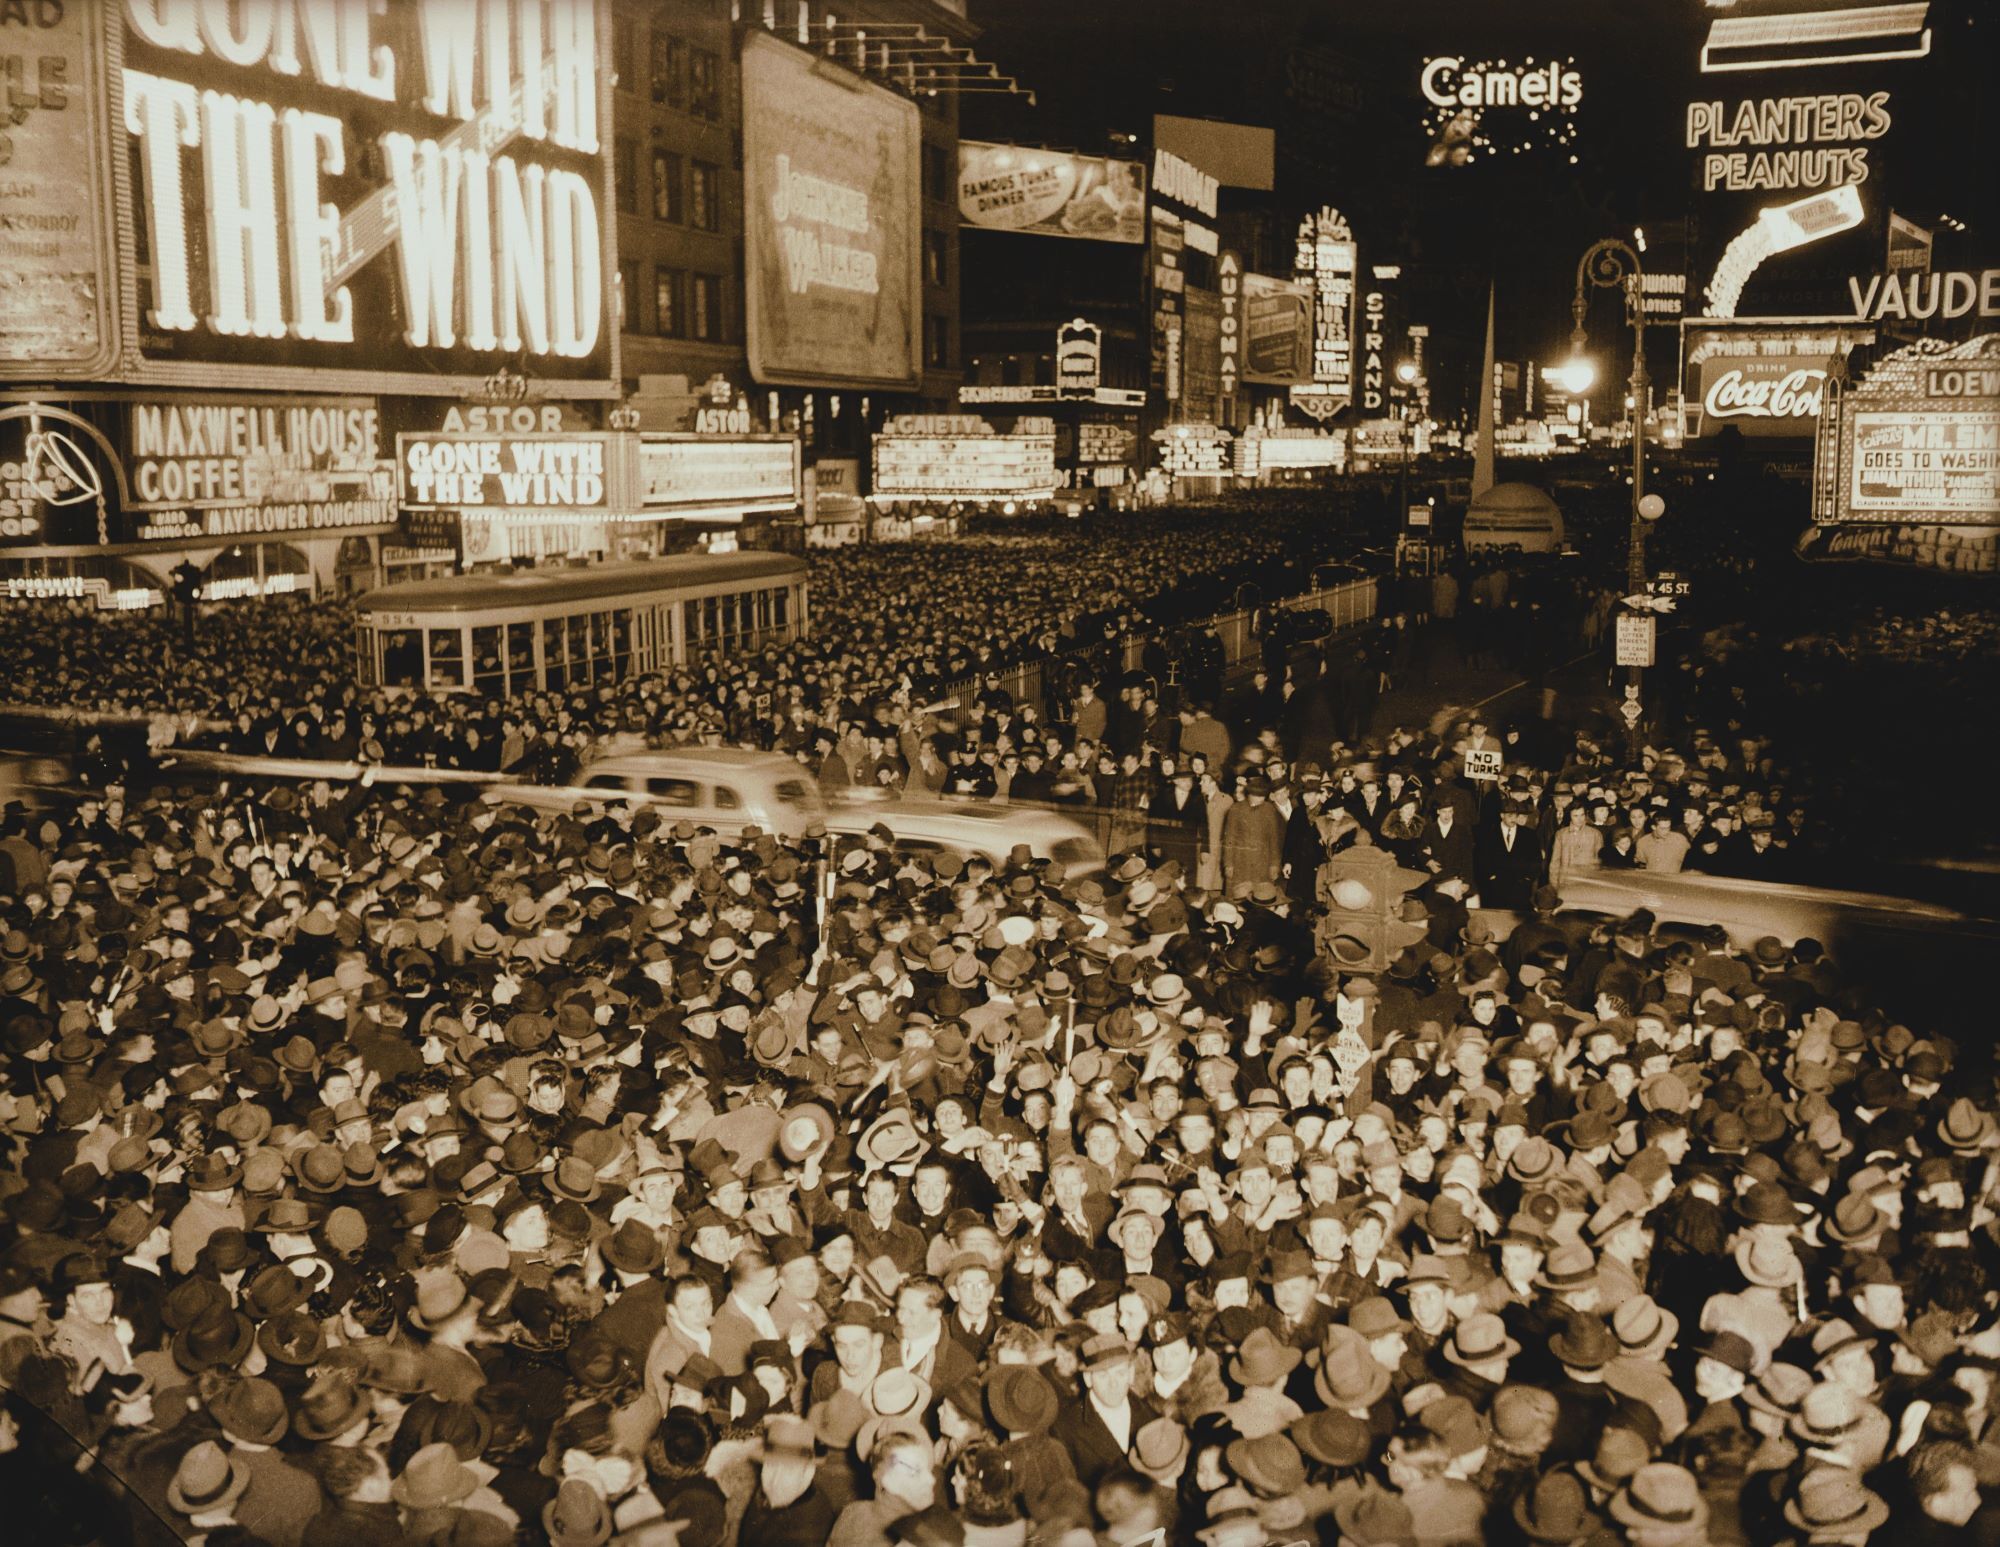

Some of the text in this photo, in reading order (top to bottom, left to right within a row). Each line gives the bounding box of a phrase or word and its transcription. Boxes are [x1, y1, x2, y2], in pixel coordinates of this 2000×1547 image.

[0, 54, 68, 111] LE
[1421, 57, 1582, 106] Camels
[1686, 92, 1891, 148] PLANTERS
[963, 175, 1015, 198] FAMOUS
[1019, 165, 1060, 186] TURKE
[1704, 148, 1870, 191] PEANUTS
[121, 68, 355, 344] THE
[979, 191, 1025, 212] DINNER
[17, 213, 79, 233] CONROY
[383, 130, 601, 359] WIND
[1849, 269, 2000, 320] VAUDE
[1219, 254, 1239, 392] AUTOMAT
[1365, 293, 1384, 409] STRAND
[1746, 363, 1788, 373] DRINK
[1704, 368, 1827, 417] Coca-Col
[138, 405, 379, 457] MAXWELL HOUSE
[442, 405, 562, 433] ASTOR
[695, 409, 750, 433] ASTOR
[899, 416, 977, 434] GAIETY
[1957, 425, 2000, 449] SM
[408, 442, 500, 474] GONE
[511, 442, 604, 474] WITH
[1865, 453, 1903, 468] GOES
[1913, 453, 1931, 468] TO
[140, 458, 262, 501] COFFEE
[410, 472, 484, 503] THE
[499, 472, 604, 504] WIND
[208, 500, 398, 535] MAYFLOWER DOUGHNUTS
[8, 576, 84, 589] DOUGHNUTS
[26, 587, 84, 598] COFFEE
[1646, 582, 1690, 594] W. 45 ST.
[1466, 763, 1500, 776] TURNS
[1473, 753, 1494, 764] NO
[1345, 1024, 1355, 1034] NO
[1339, 1038, 1366, 1053] ARKING
